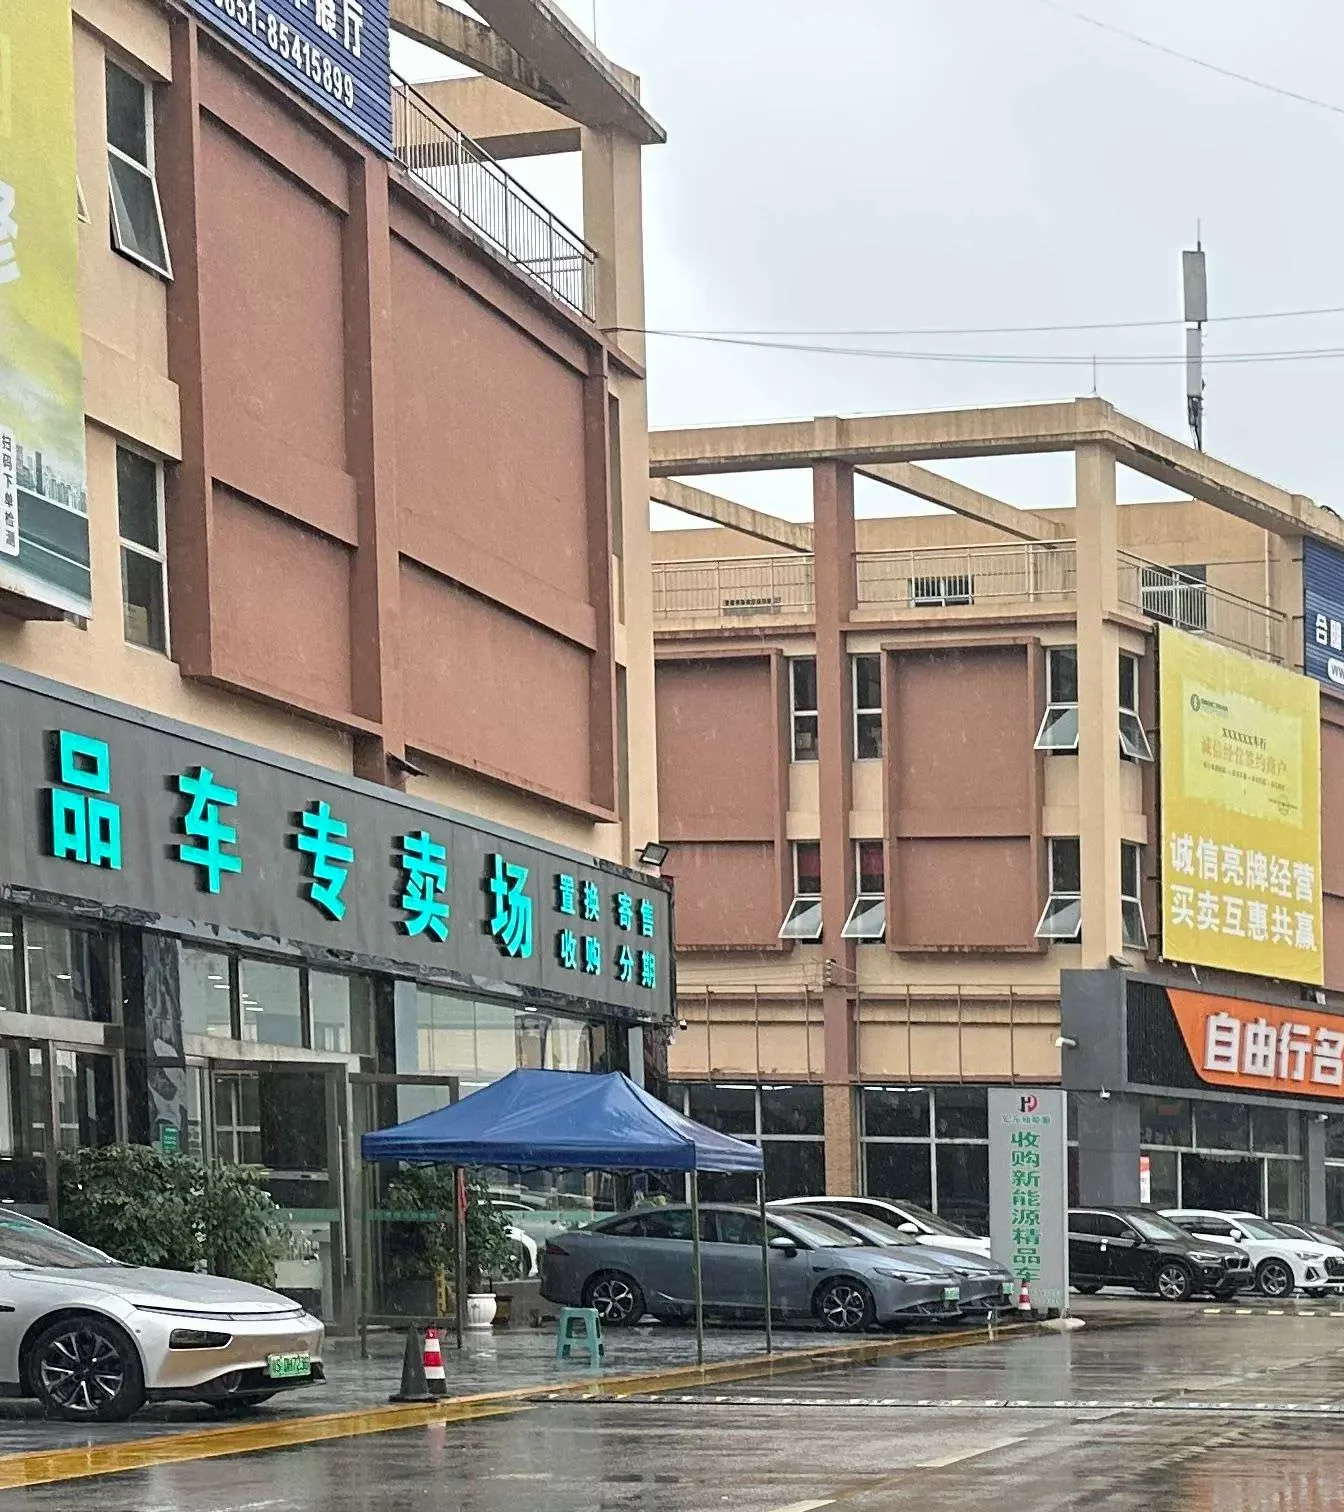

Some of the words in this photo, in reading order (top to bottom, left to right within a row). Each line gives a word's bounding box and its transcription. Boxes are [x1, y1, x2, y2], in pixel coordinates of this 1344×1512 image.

[217, 0, 353, 109] 851-85415899
[51, 729, 533, 959] 品车专卖场
[1170, 831, 1315, 903] 诚信亮牌经营
[560, 873, 600, 921] 置换
[618, 891, 654, 937] 寄售
[1170, 884, 1317, 952] 买卖互惠共赢
[561, 929, 600, 976] 收购
[620, 944, 656, 989] 分期
[1011, 1131, 1041, 1282] 收购新能源精品车
